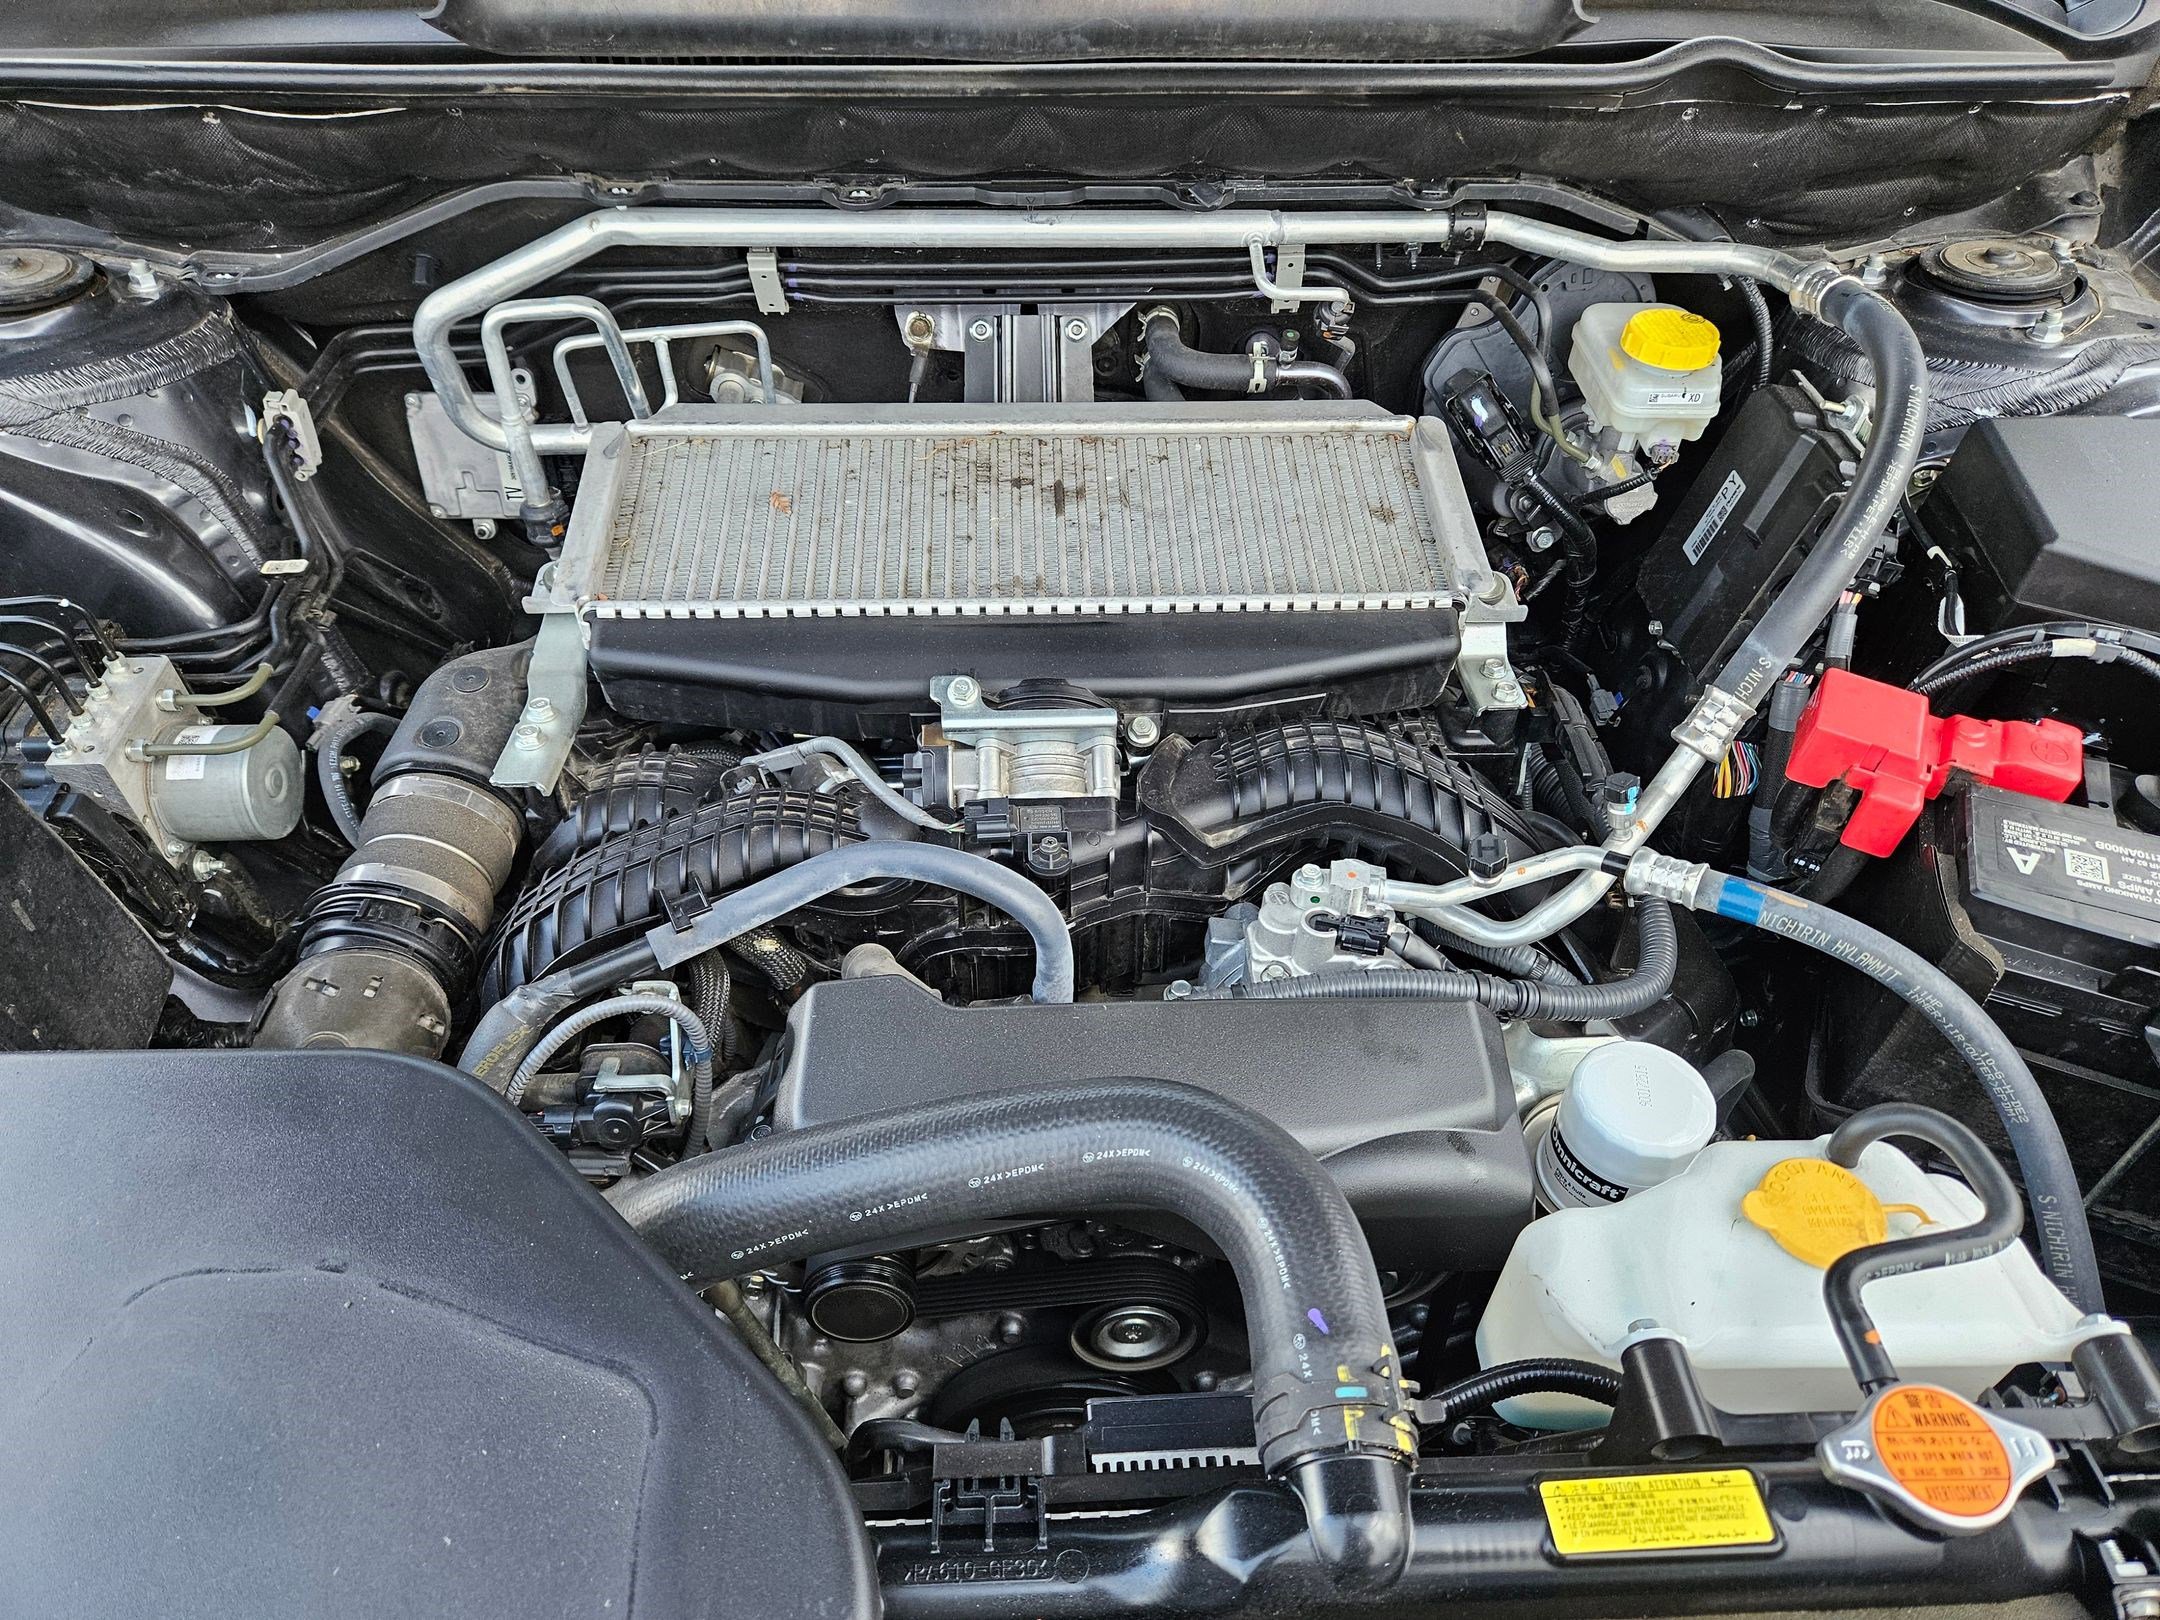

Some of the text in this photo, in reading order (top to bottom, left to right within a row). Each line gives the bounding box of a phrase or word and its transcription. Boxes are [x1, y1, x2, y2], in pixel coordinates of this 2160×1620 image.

[1688, 393, 1700, 402] XD
[504, 487, 524, 500] TV
[2006, 846, 2041, 876] A
[2077, 878, 2102, 891] AMPS
[2117, 880, 2154, 896] AMPS
[1758, 911, 1832, 946] NICHIRIN
[1912, 1412, 1970, 1427] WARNING
[1598, 1478, 1701, 1494] CAUTION ATTENTION
